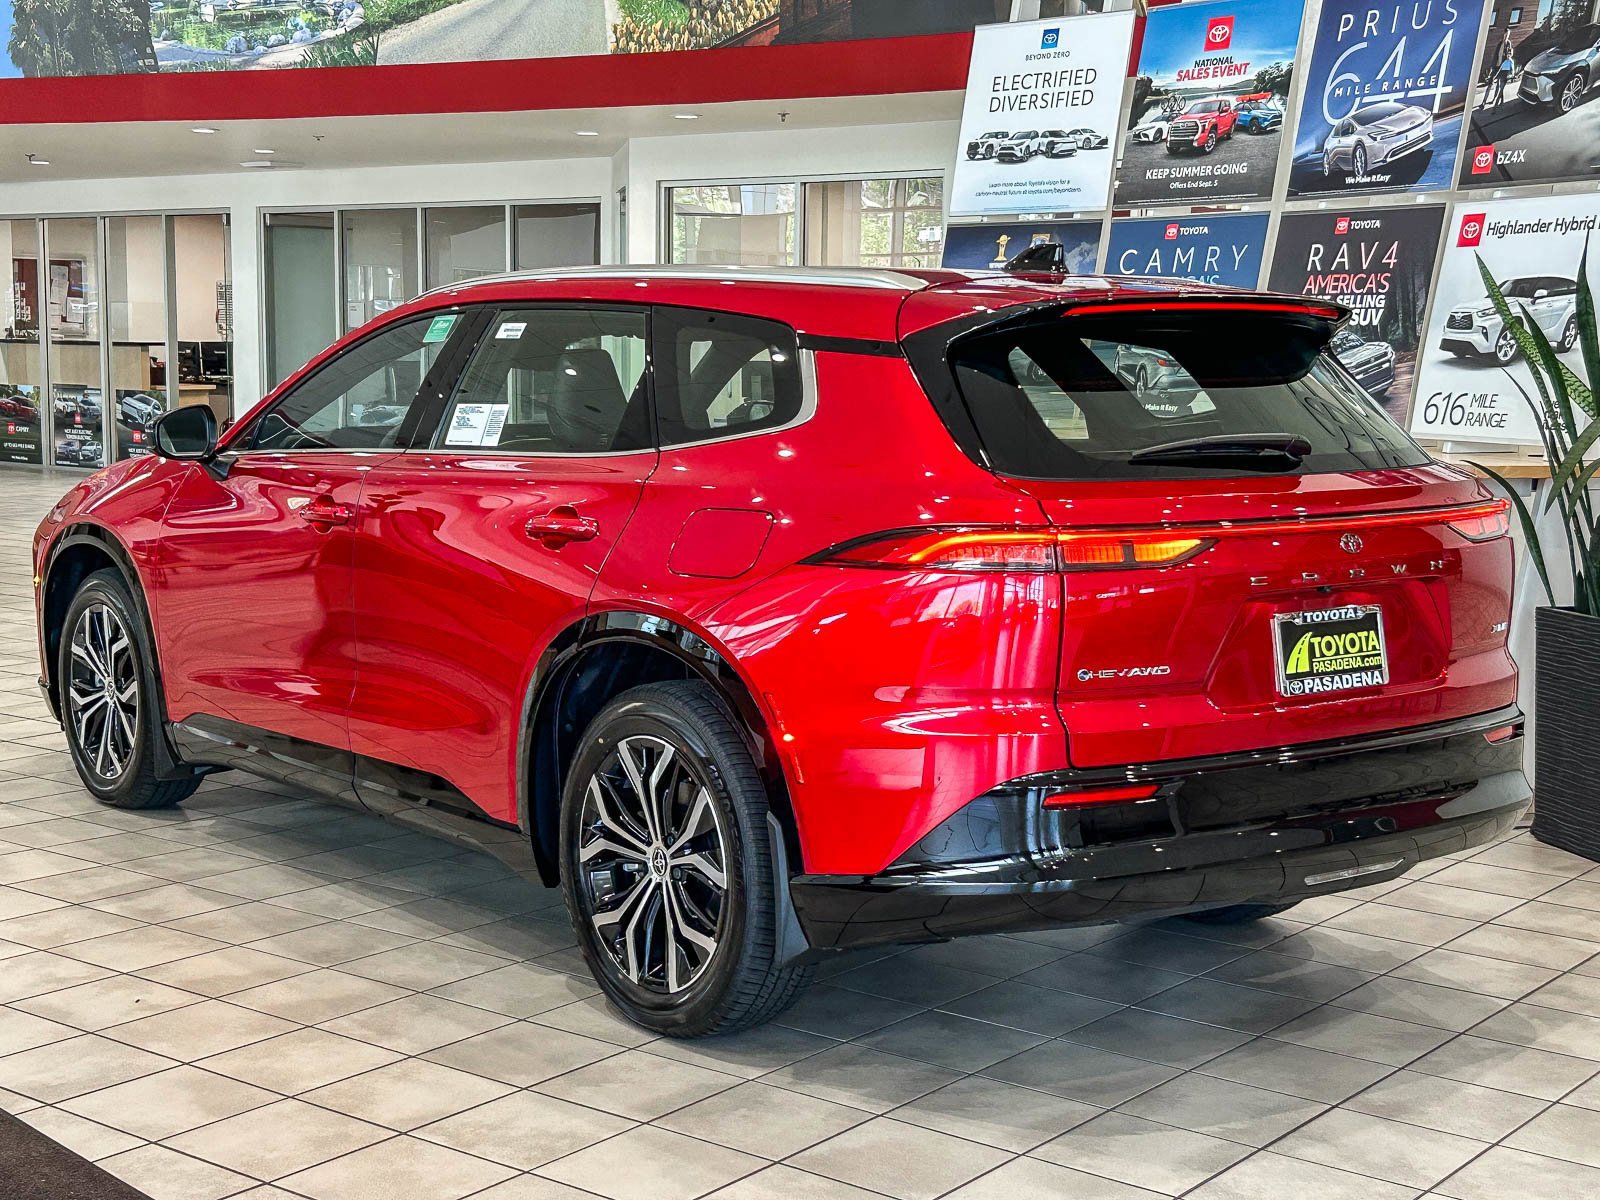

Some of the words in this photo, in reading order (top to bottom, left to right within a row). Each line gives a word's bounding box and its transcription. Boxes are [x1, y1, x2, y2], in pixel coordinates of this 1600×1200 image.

[1337, 0, 1458, 42] PRIUS
[1194, 56, 1233, 68] NATIONAL
[992, 68, 1097, 92] ELECTRIFIED
[1176, 67, 1210, 82] SALES
[1212, 63, 1250, 78] EVENT
[1334, 83, 1370, 98] MILE
[1382, 74, 1437, 91] RANGE
[989, 89, 1094, 112] DIVERSIFIED
[1497, 149, 1526, 164] bZ4X
[1146, 168, 1169, 180] KEEP
[1170, 165, 1211, 178] SUMMER
[1214, 163, 1248, 175] GOING
[1377, 174, 1391, 182] Easy
[1199, 180, 1212, 188] Sept.
[1180, 226, 1208, 235] TOYOTA
[1351, 219, 1381, 230] TOYOTA
[1487, 219, 1553, 239] Highlander
[1554, 215, 1597, 235] Hybrid
[1120, 244, 1248, 274] CAMRY
[1307, 240, 1398, 272] RAV4
[1302, 273, 1391, 294] AMERICA'S
[1349, 309, 1384, 326] SUV
[1165, 404, 1178, 412] Easy
[1424, 392, 1470, 426] 616
[1465, 412, 1508, 428] RANGE
[1470, 394, 1498, 408] MILE
[1304, 608, 1356, 622] TOYOTA
[1310, 631, 1380, 657] TOYOTA
[1313, 655, 1382, 673] PASADENA.com
[1305, 671, 1383, 693] PASADENA
